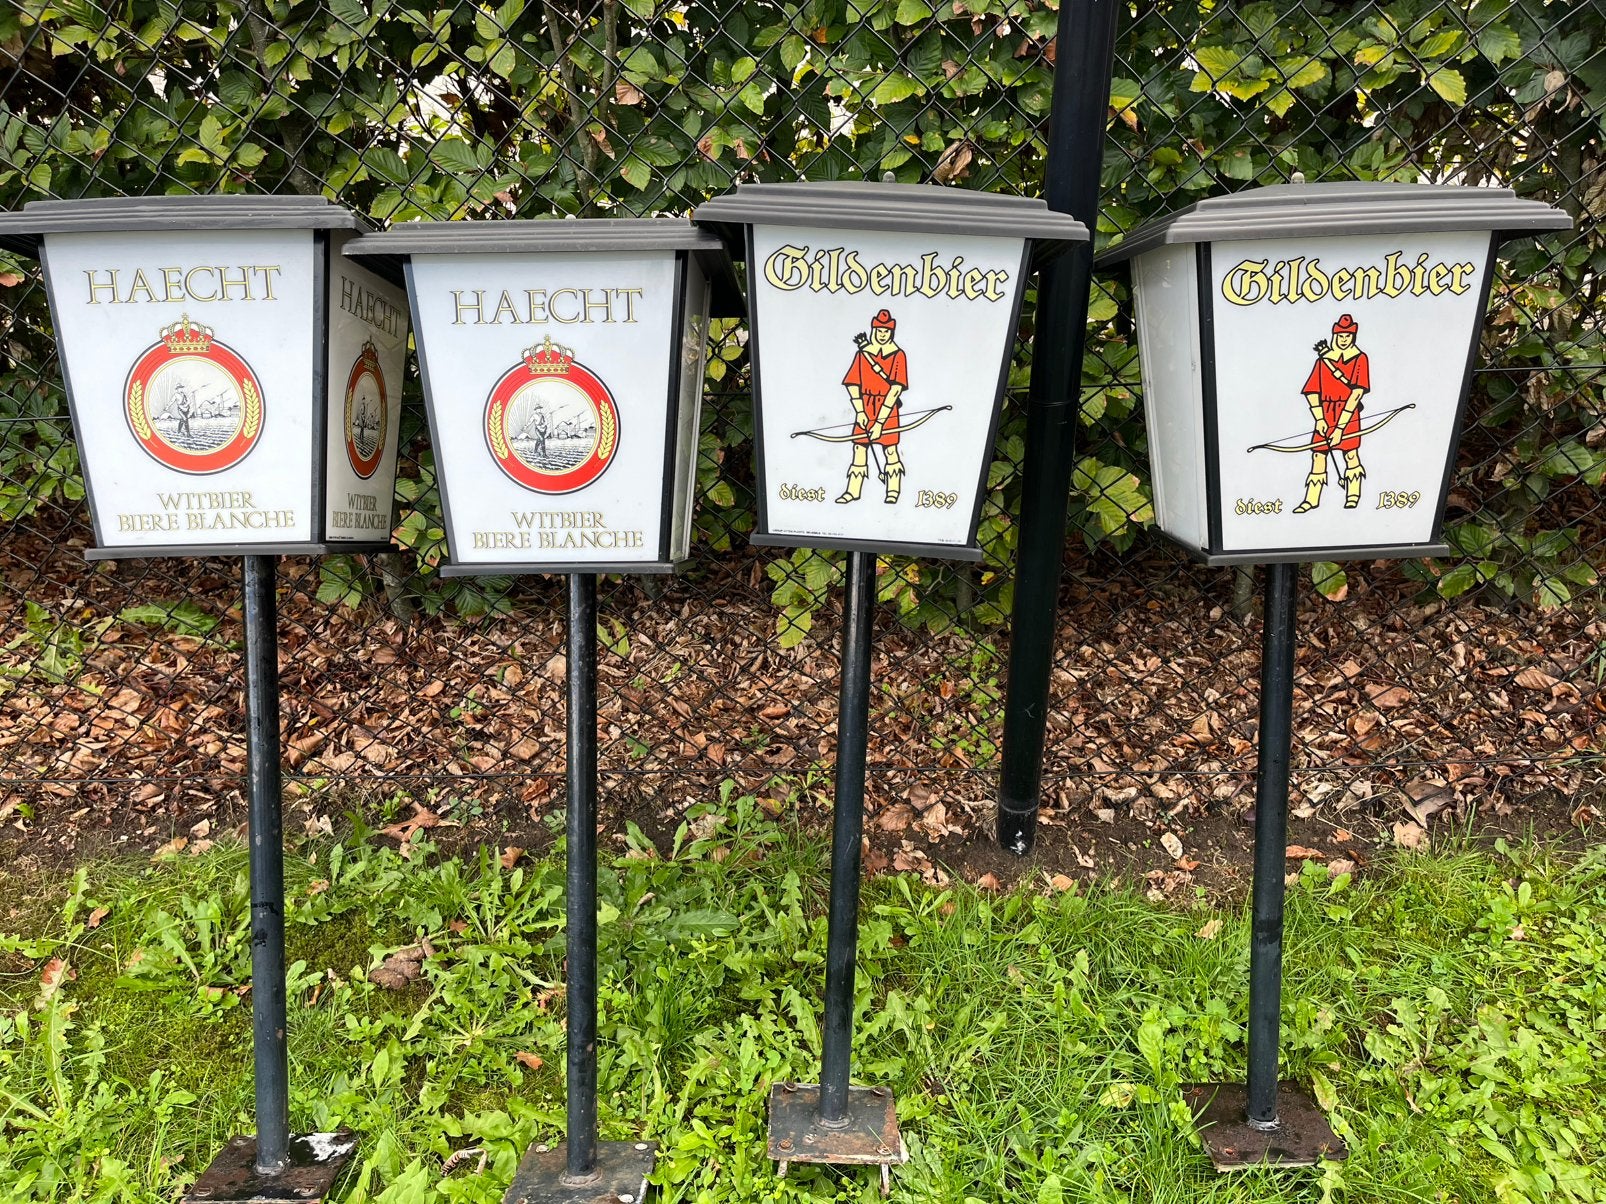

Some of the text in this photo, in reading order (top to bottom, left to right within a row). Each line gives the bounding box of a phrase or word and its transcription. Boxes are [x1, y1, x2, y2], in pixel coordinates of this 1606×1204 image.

[764, 244, 1010, 302] Gildenbier
[1222, 250, 1476, 306] Gildenbier
[83, 265, 281, 304] HAECHT
[340, 276, 402, 340] HAECHT
[450, 287, 643, 325] HAECHT
[157, 491, 257, 511] WITBIER
[778, 482, 826, 502] diest
[915, 489, 959, 510] 1389
[1375, 491, 1422, 510] 1389
[346, 493, 378, 512] WITBIER
[1234, 497, 1283, 516] diest
[117, 510, 296, 532] BIERE BLANCHE
[332, 510, 388, 530] BIERE BLANCHE
[511, 511, 607, 529] WITBIER
[472, 530, 643, 550] BIERE BLANCHE
